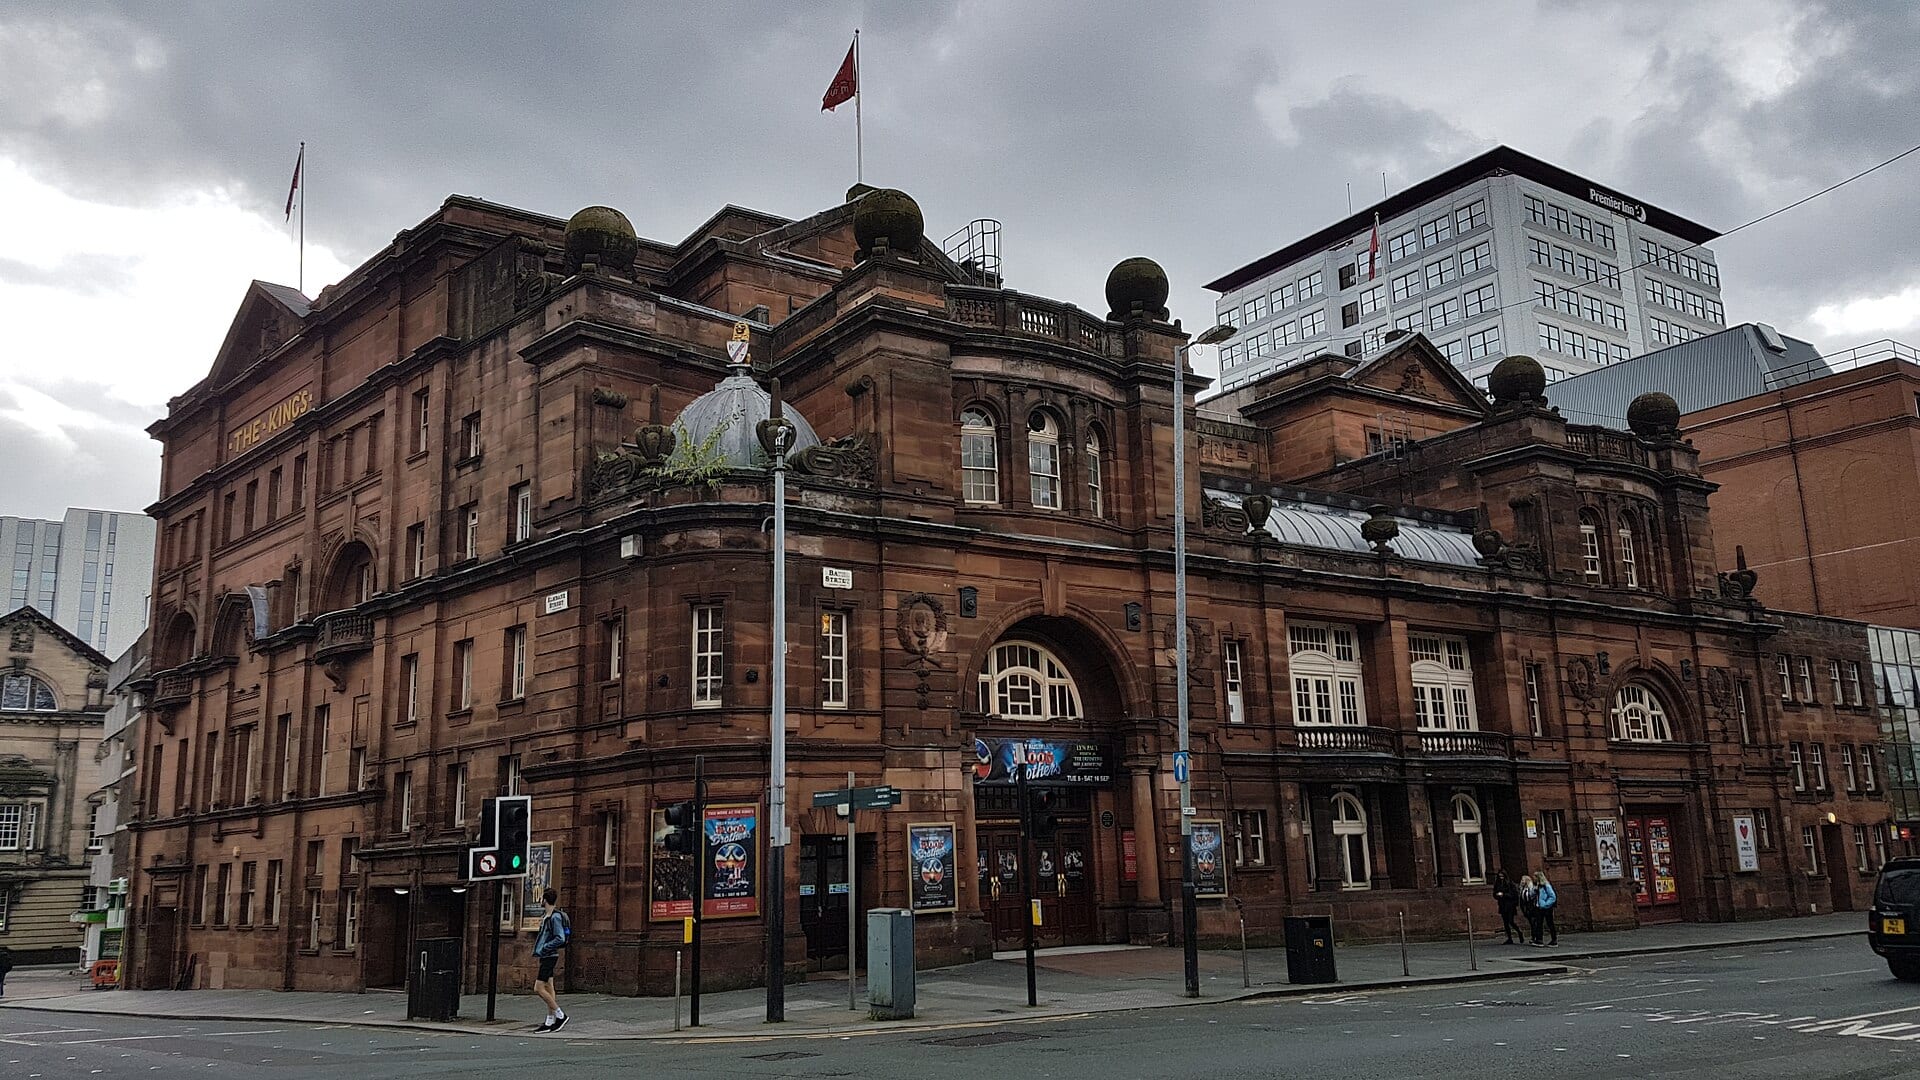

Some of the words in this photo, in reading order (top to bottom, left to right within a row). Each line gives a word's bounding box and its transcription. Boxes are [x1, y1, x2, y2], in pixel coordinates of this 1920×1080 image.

[1589, 188, 1622, 211] Premier
[1621, 200, 1635, 215] Inn
[233, 418, 261, 453] THE
